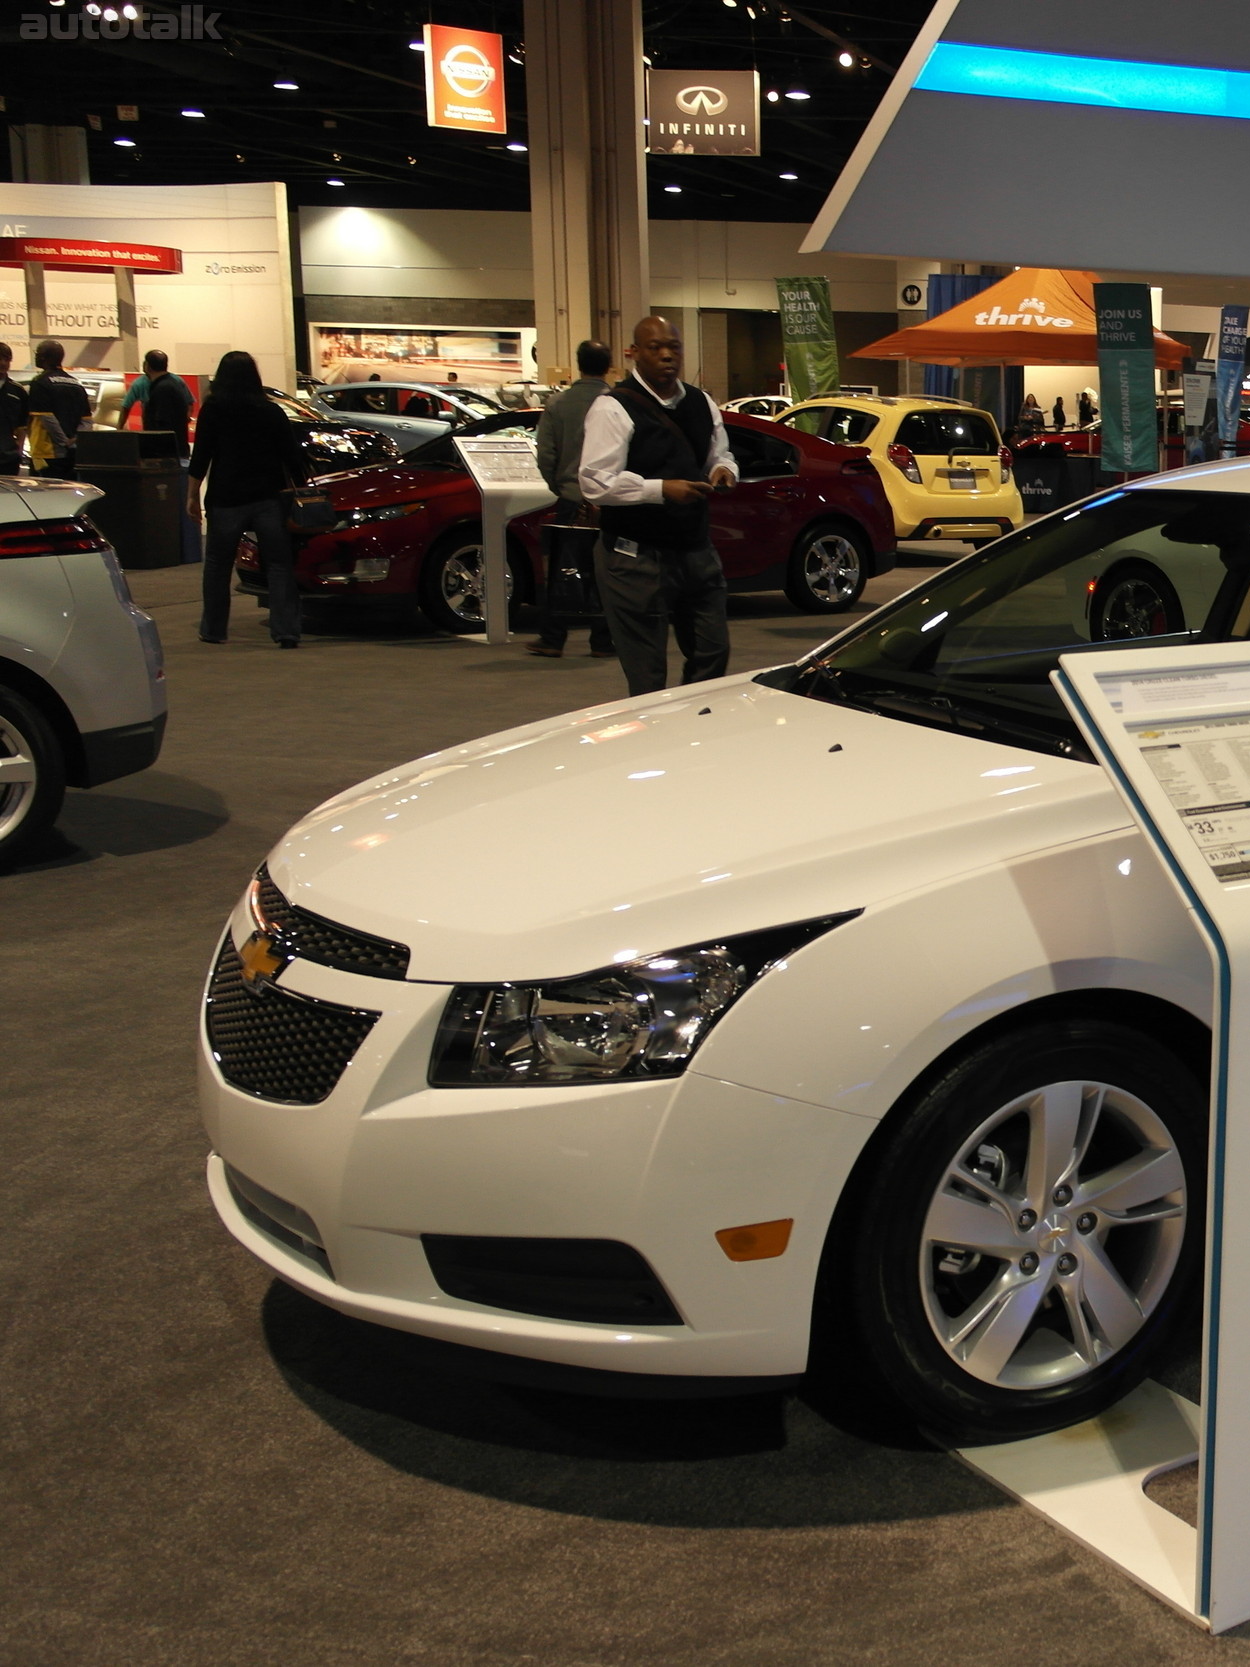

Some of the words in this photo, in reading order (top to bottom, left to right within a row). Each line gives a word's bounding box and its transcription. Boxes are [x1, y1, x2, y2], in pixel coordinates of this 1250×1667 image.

[660, 123, 746, 136] INFINITI
[61, 246, 111, 258] Innovation
[112, 250, 131, 260] that
[782, 291, 810, 300] YOUR
[784, 302, 820, 312] HEALTH
[975, 306, 1073, 328] thrive
[1099, 309, 1126, 319] JOIN
[1128, 309, 1142, 319] US
[786, 324, 818, 335] CAUSE
[1100, 321, 1123, 331] AND
[1100, 332, 1136, 342] THRIVE
[1119, 369, 1132, 433] PERMANENTE
[1022, 483, 1052, 495] thrive
[1194, 821, 1215, 834] 33
